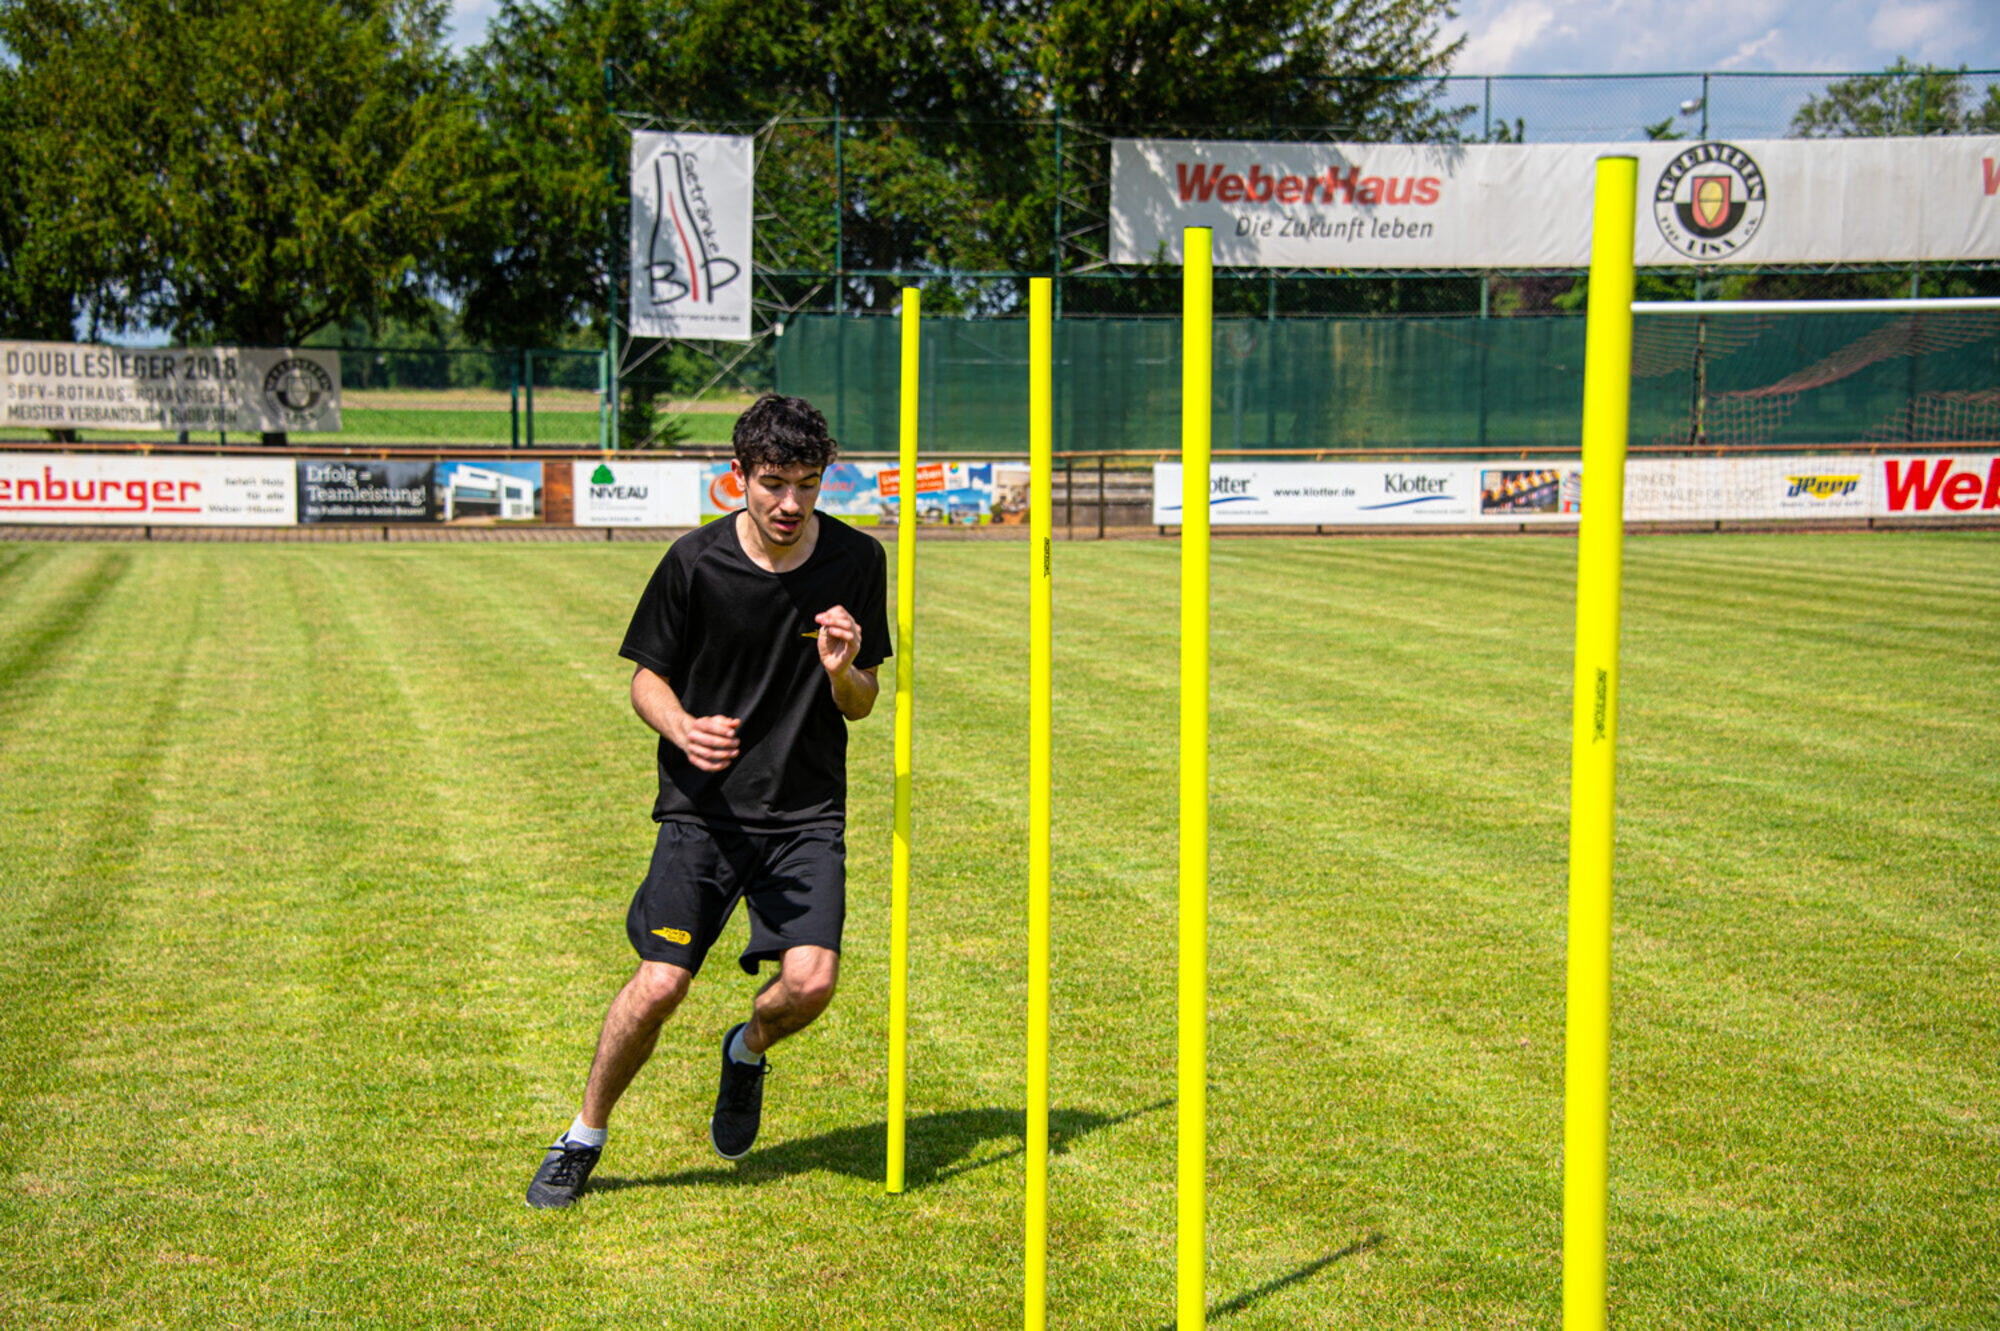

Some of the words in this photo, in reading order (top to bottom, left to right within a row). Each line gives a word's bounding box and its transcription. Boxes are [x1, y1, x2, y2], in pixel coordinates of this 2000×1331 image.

[1176, 163, 1442, 206] WeberHaus
[1235, 216, 1273, 238] Die
[1279, 216, 1365, 242] Zukunft
[1371, 216, 1433, 239] leben
[7, 350, 176, 380] DOUBLESIEGER
[185, 355, 238, 380] 2018
[8, 405, 65, 421] MEISTER
[306, 464, 357, 486] Erfolg
[1209, 476, 1250, 493] otter
[1384, 472, 1448, 494] Klotter
[306, 484, 426, 506] Teamleistung!
[590, 486, 649, 500] NIVEAU
[1273, 487, 1357, 498] www.klotter.de
